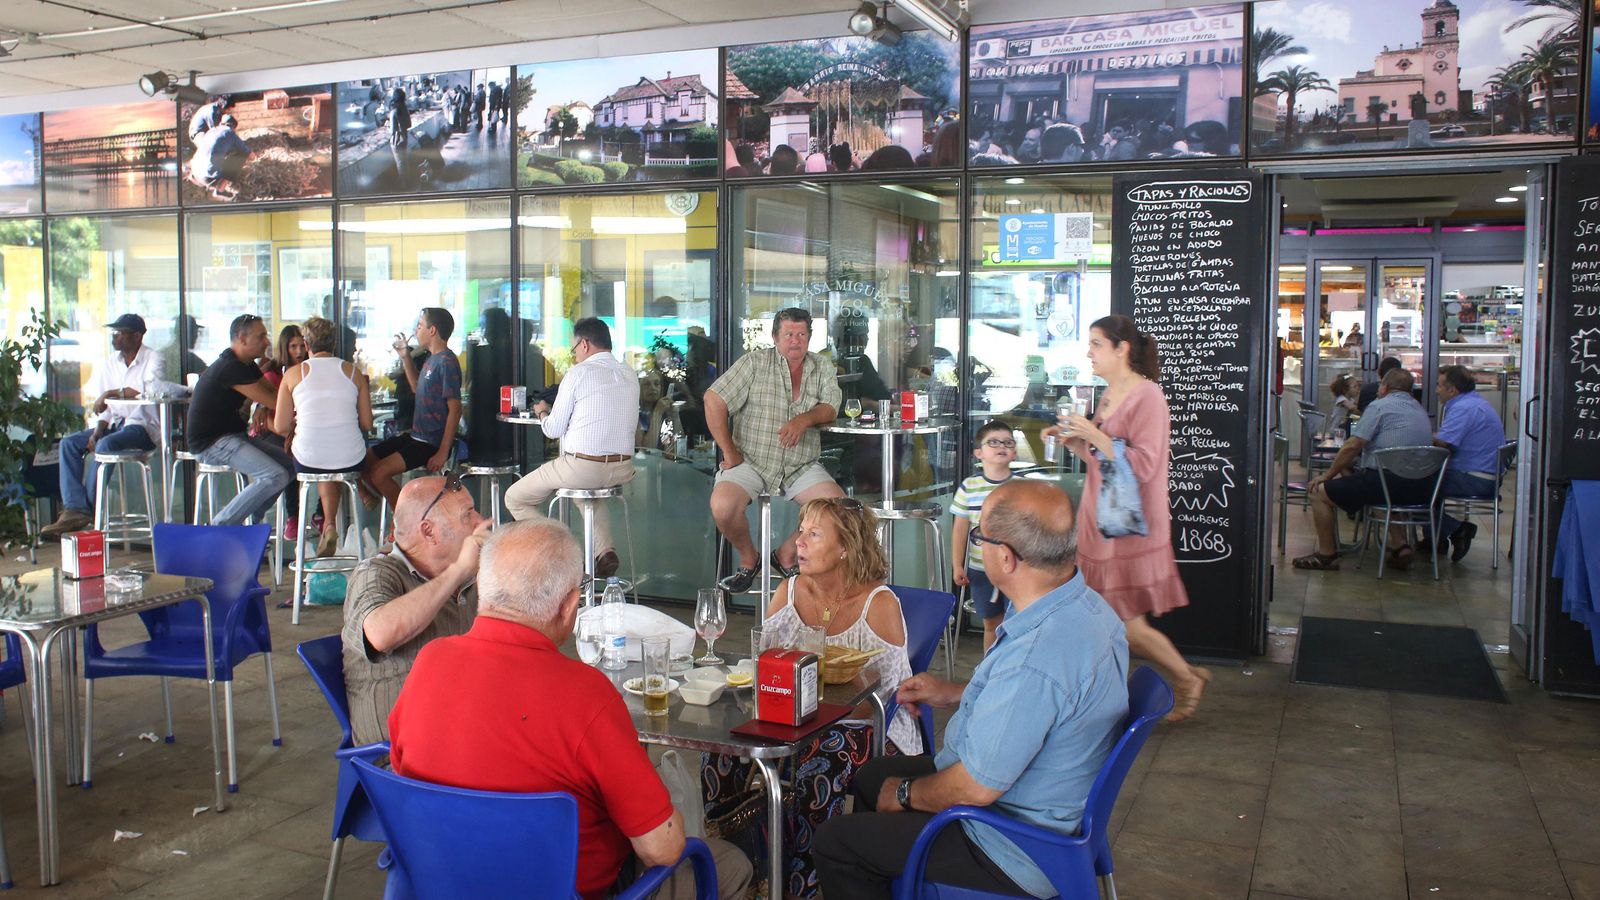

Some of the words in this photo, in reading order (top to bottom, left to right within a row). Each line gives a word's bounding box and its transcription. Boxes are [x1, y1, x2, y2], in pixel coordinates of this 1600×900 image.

[1041, 34, 1074, 48] BAR
[1081, 29, 1132, 44] CASA
[1142, 18, 1234, 38] MIGUEL
[1108, 52, 1186, 68] DESAYUNOS
[1017, 64, 1050, 74] MIGUEL
[804, 68, 834, 90] BARRIO
[838, 63, 858, 71] REINA
[1132, 190, 1174, 200] TAPAS
[1178, 188, 1187, 198] Y
[1190, 185, 1249, 198] RACIONES
[1136, 203, 1162, 212] ATUN
[1132, 212, 1168, 220] CHOCOS
[1170, 210, 1212, 220] FRITOS
[1129, 222, 1165, 234] PAVIAS
[1188, 220, 1234, 230] BACALAO
[1131, 232, 1163, 244] HUEVOS
[1189, 230, 1220, 238] CHOCO
[1187, 240, 1222, 249] ADOBO
[1129, 252, 1201, 264] BOQUERONES
[1131, 262, 1174, 274] TORTILLAS
[1191, 258, 1234, 268] GAMBAS
[1134, 272, 1185, 282] ACEITUNAS
[1187, 269, 1224, 279] FRITAS
[1131, 282, 1176, 296] BACALAO
[1200, 280, 1240, 292] ROTEÑA
[1183, 296, 1208, 306] SALSA
[1134, 306, 1161, 316] ATUN
[1134, 316, 1170, 324] HUEVOS
[1173, 314, 1221, 323] RELLENOS
[1137, 324, 1194, 332] ALBONDIGAS
[1210, 323, 1238, 332] CHOCO
[1196, 340, 1236, 349] GAMBAS
[1173, 372, 1222, 382] PIMENTON
[1176, 393, 1187, 401] DE
[1189, 392, 1228, 402] MARISCO
[1187, 402, 1239, 412] MAYONESA
[1182, 426, 1212, 436] CHOCO
[1178, 514, 1230, 526] ONUBENSE
[1180, 527, 1226, 552] 1868
[760, 684, 792, 695] Cruzcampo
